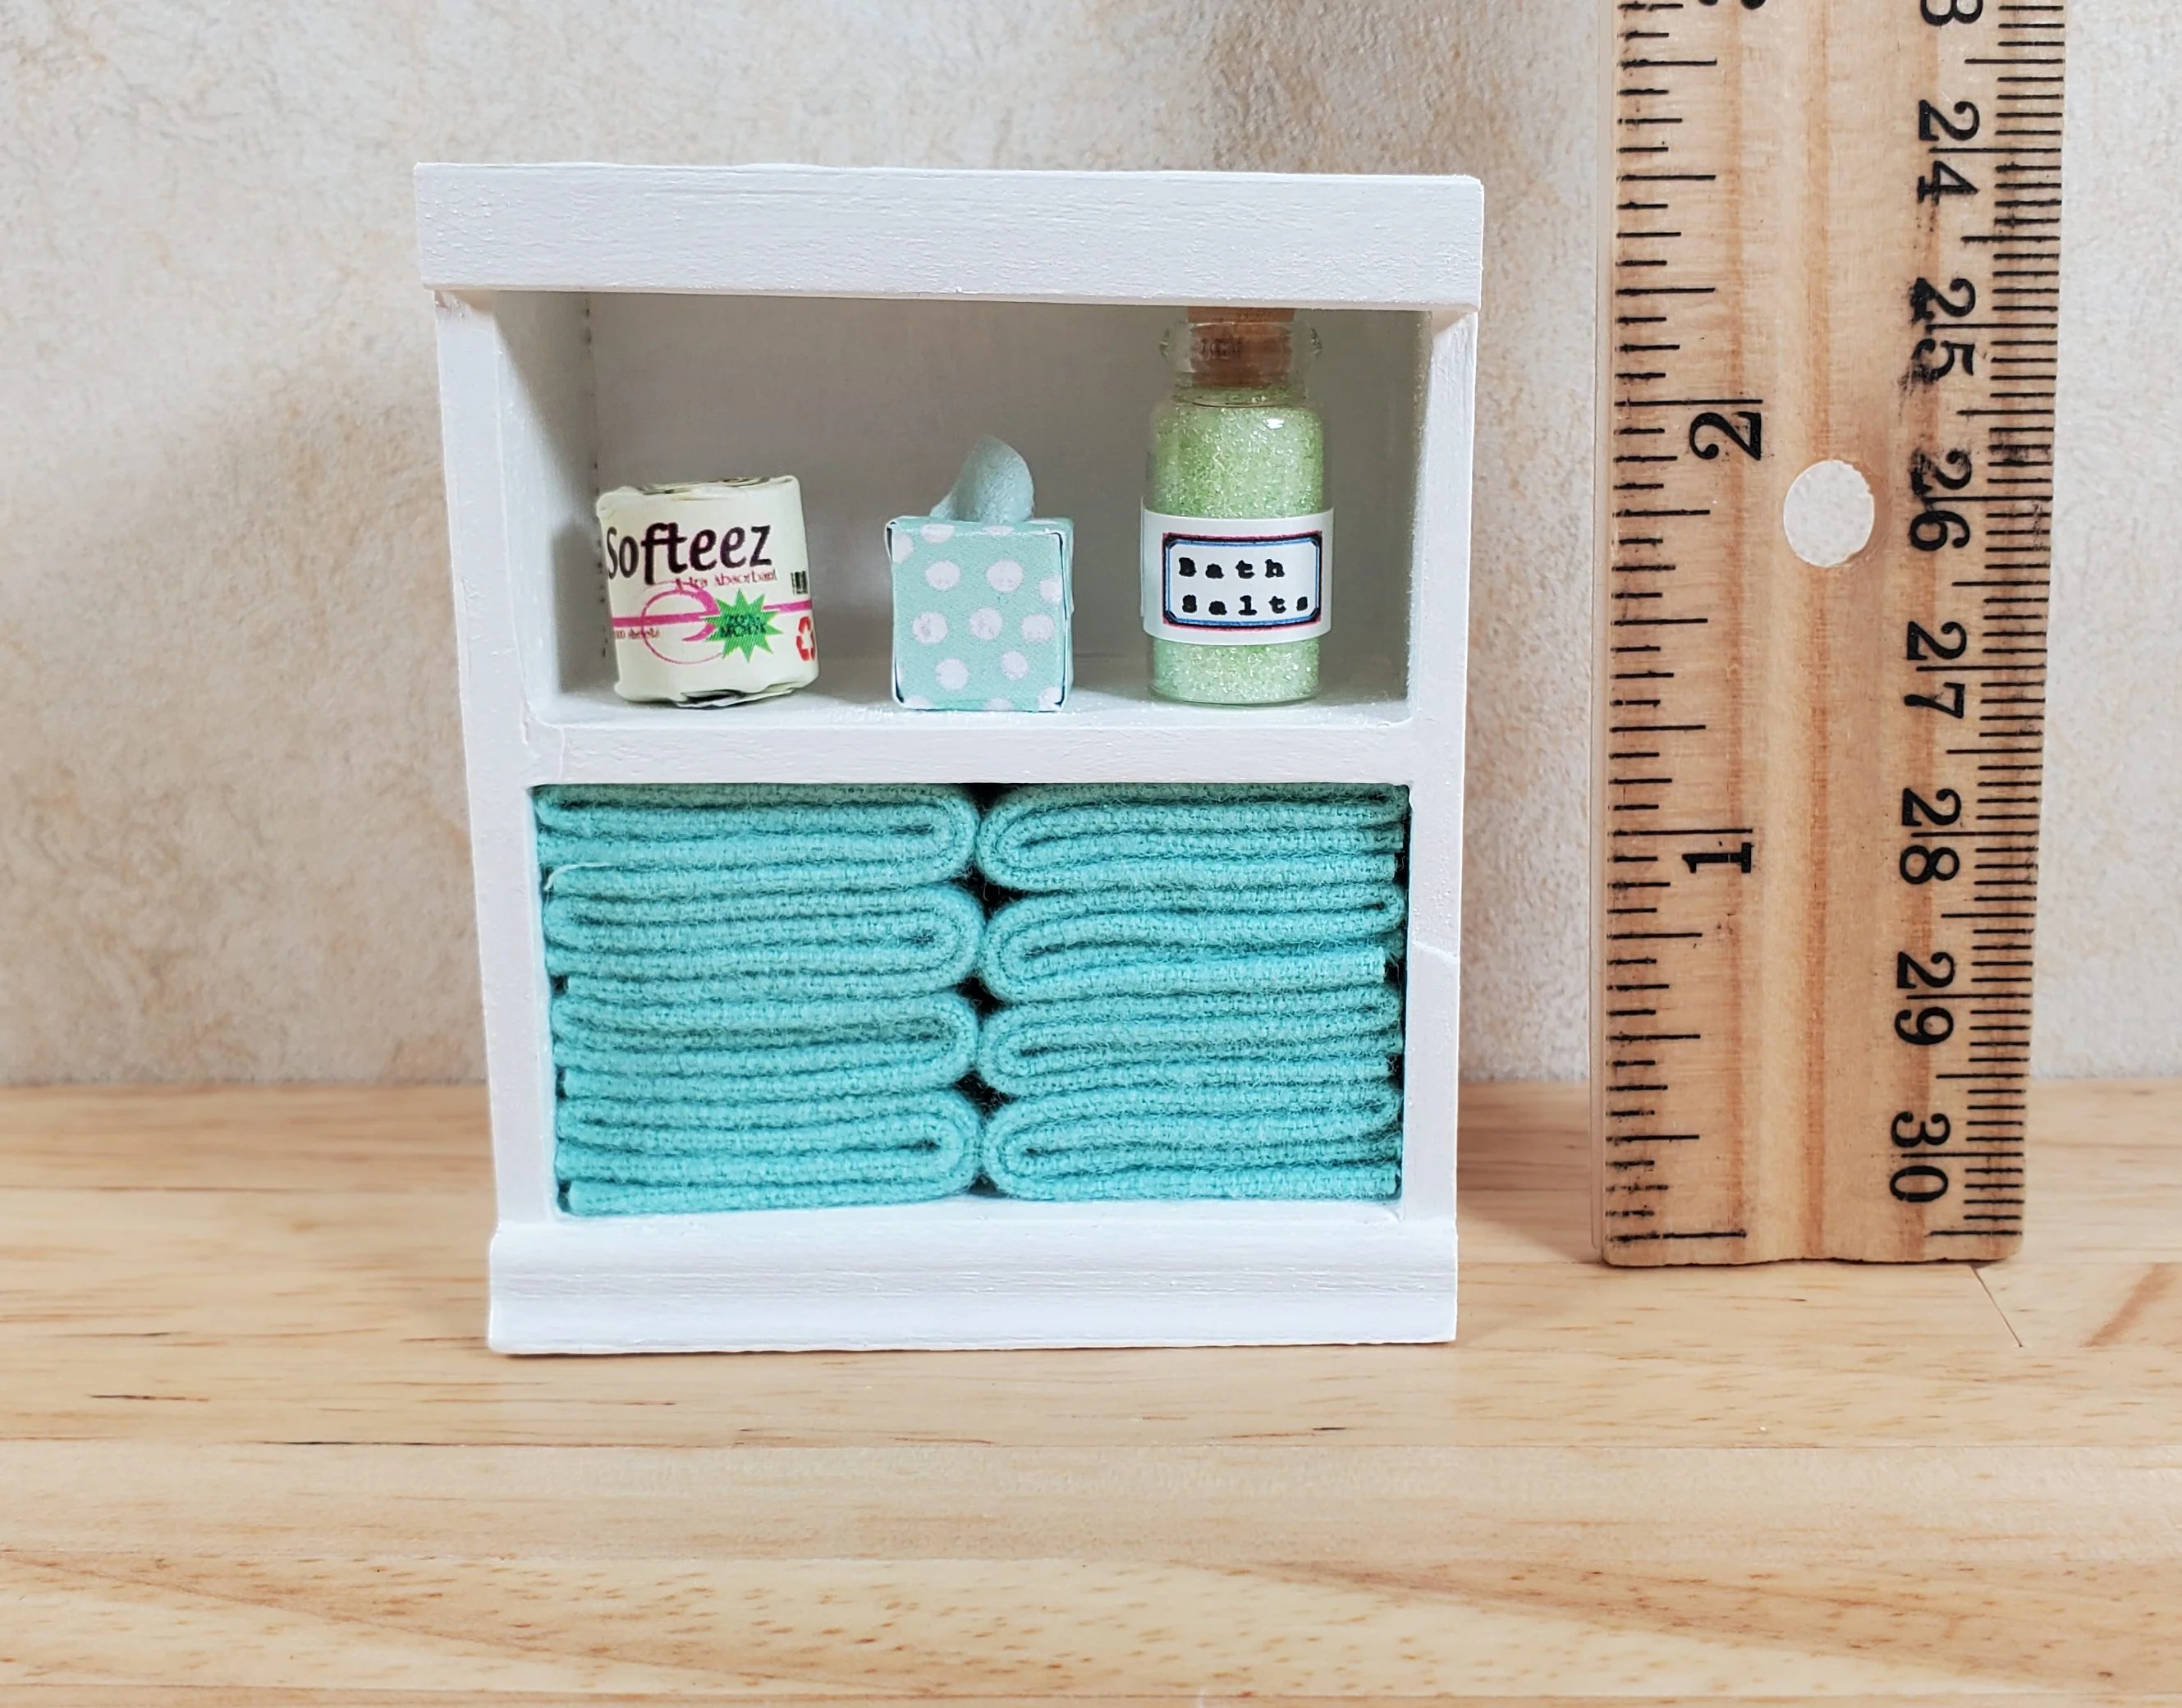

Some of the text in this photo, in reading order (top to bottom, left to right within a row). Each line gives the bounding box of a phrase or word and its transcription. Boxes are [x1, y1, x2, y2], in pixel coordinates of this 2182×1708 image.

[1917, 99, 1980, 204] 24
[1910, 277, 1976, 384] 25
[1689, 411, 1762, 461] 2
[1909, 449, 1973, 552] 26
[607, 522, 772, 585] Softeez
[1178, 557, 1285, 579] Bath
[1904, 621, 1967, 719] 27
[1682, 842, 1752, 873] 1
[1900, 788, 1962, 885] 28
[1894, 951, 1956, 1046] 29
[1889, 1112, 1951, 1203] 30
